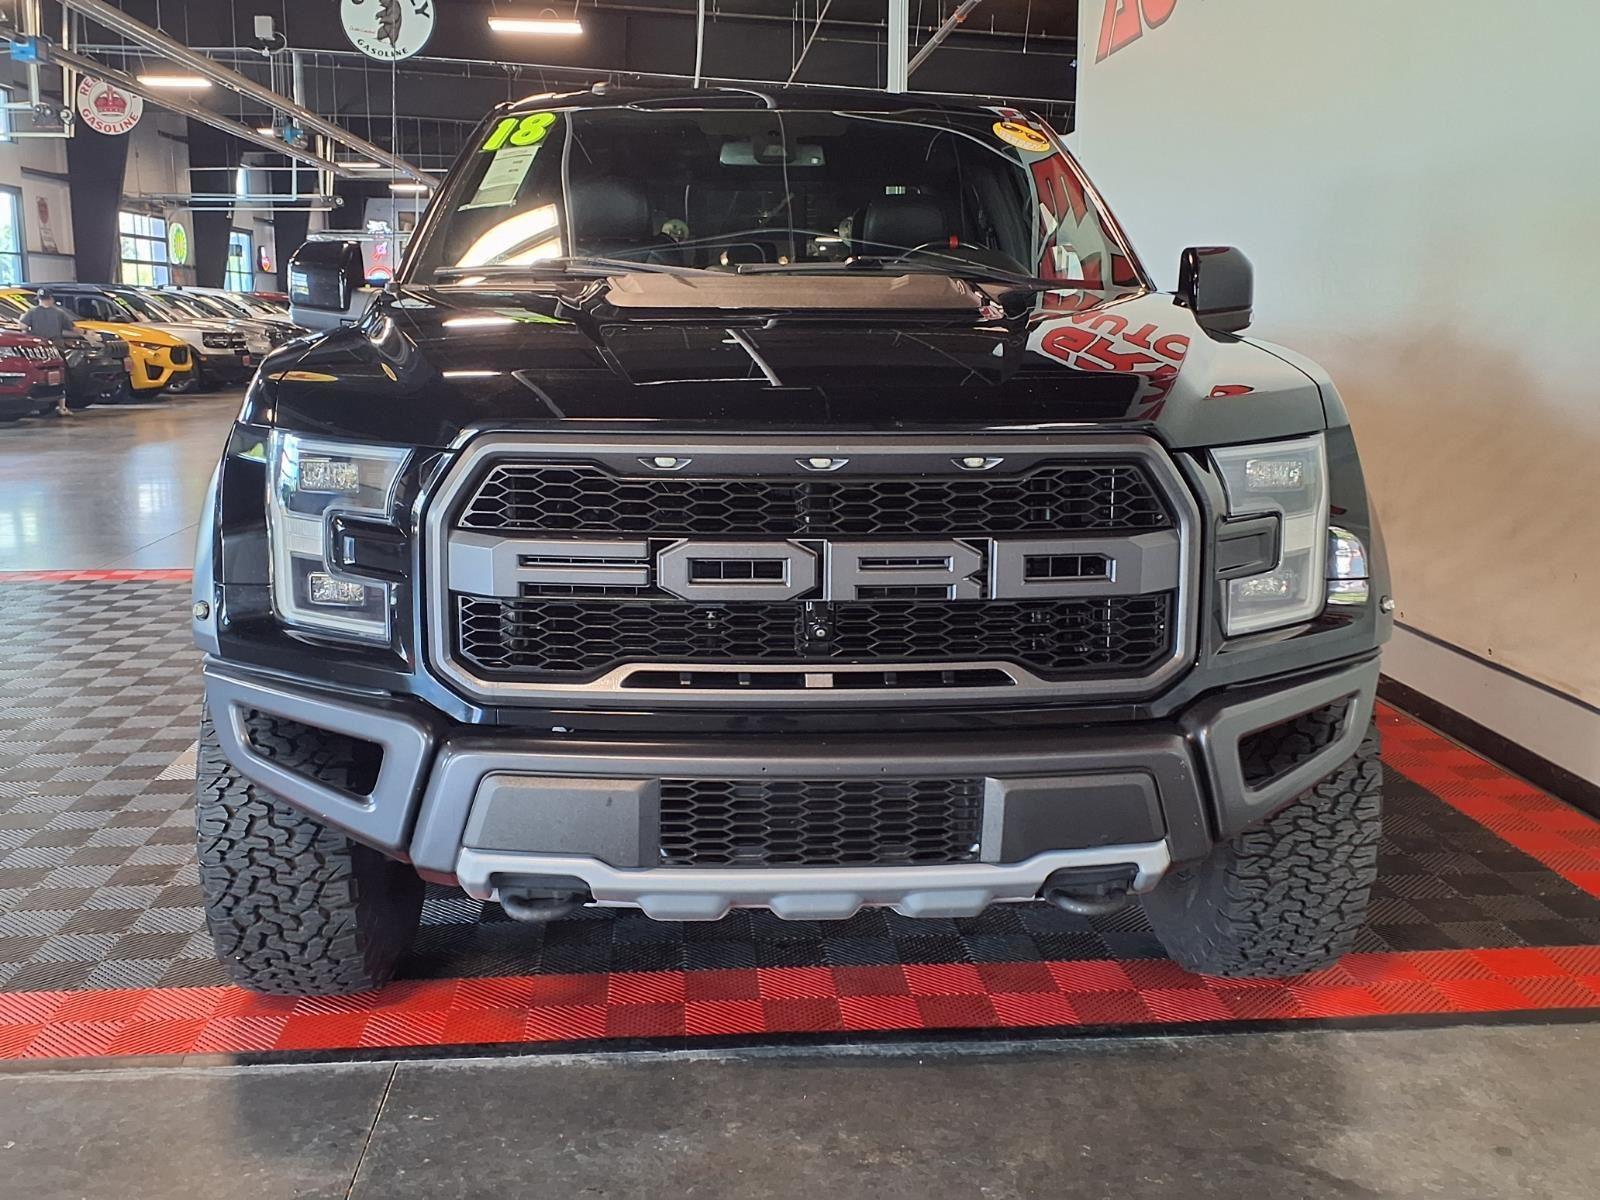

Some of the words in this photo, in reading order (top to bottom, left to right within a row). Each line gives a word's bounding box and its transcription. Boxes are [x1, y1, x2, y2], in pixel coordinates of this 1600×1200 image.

[357, 38, 409, 58] GASOLINE
[82, 108, 139, 133] GASOLINE
[482, 112, 557, 151] 18
[449, 537, 1179, 600] FORD
